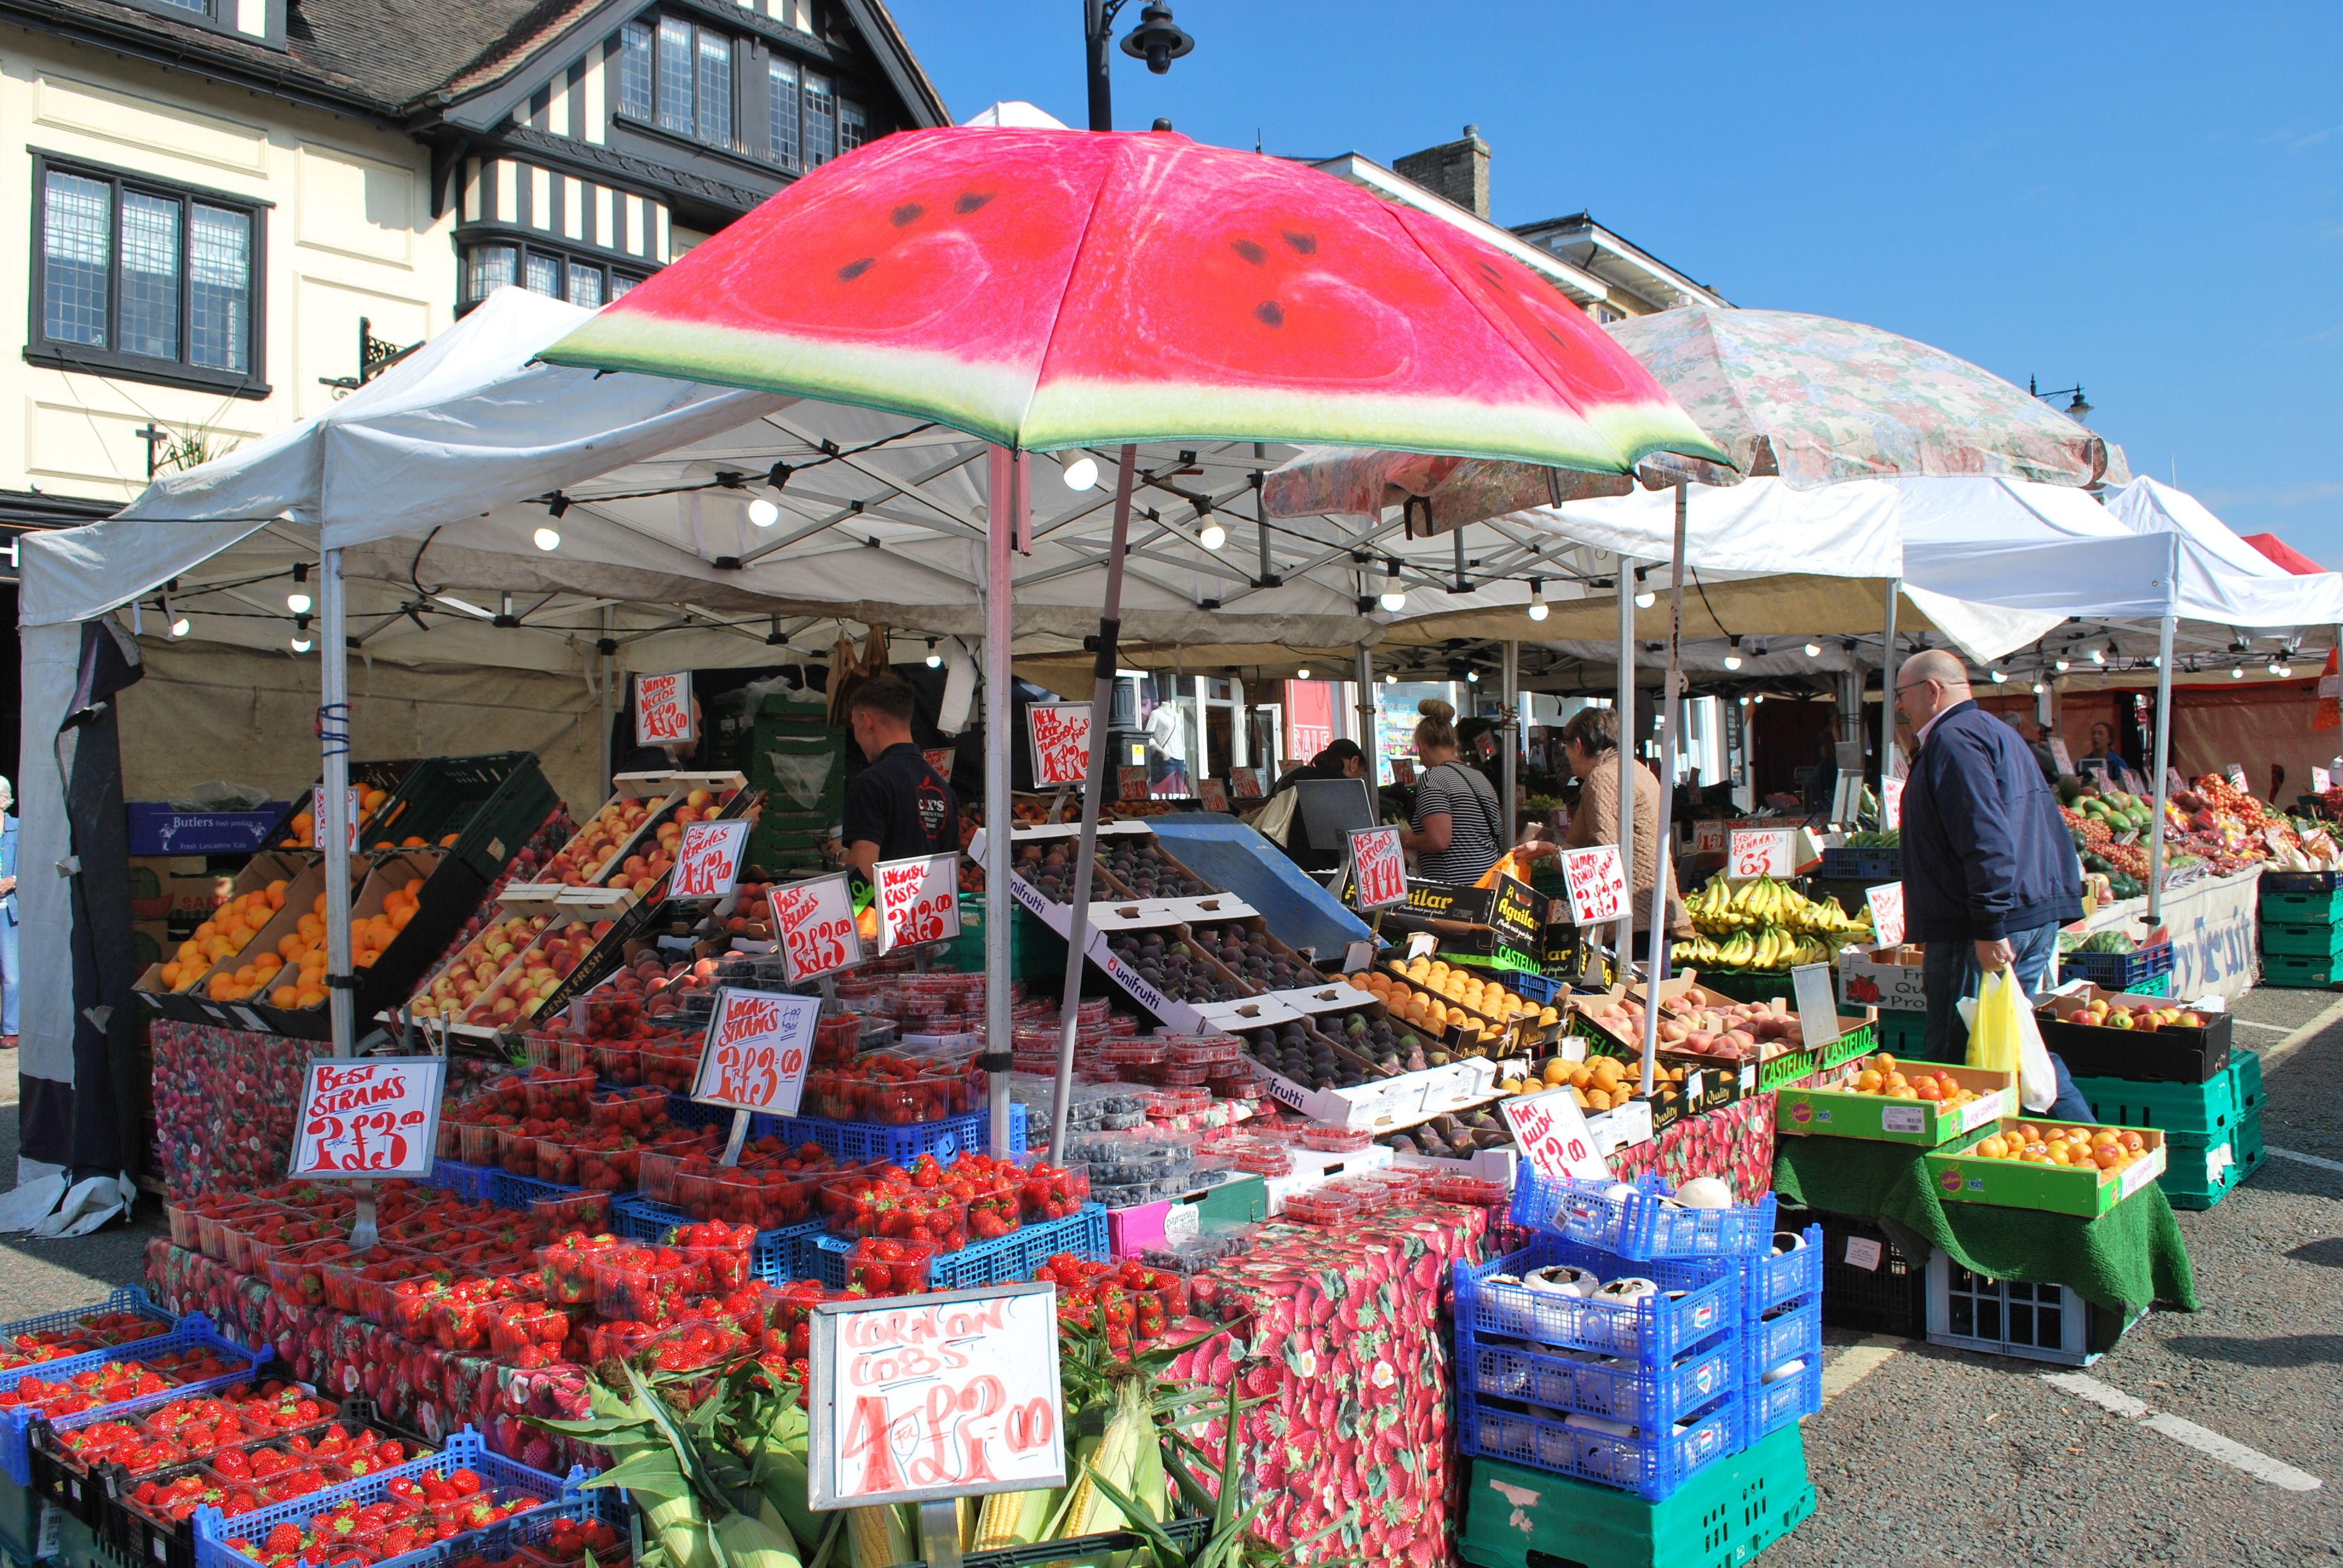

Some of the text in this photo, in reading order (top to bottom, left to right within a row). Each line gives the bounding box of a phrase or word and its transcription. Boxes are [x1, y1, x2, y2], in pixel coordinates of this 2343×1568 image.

[1033, 708, 1056, 730] NEW
[1294, 729, 1329, 766] SALE
[174, 817, 214, 827] Butlers
[1357, 830, 1392, 872] APRICOTS
[1568, 853, 1598, 872] JUMBO
[1732, 832, 1778, 857] BANANAS
[773, 886, 805, 915] BEST
[1011, 878, 1046, 914] nifrutti
[1498, 898, 1541, 931] Aguilar
[2194, 904, 2252, 988] Fruit
[571, 950, 604, 987] FRESH
[1116, 967, 1161, 1010] unifrutti
[718, 1008, 781, 1047] STRAWS
[1522, 1031, 1547, 1047] Quality
[308, 1076, 407, 1117] STRAWS
[316, 1064, 380, 1093] BEST
[1706, 1086, 1730, 1105] Quality
[1653, 1105, 1678, 1129] Quality
[303, 1116, 344, 1172] 2
[845, 1297, 1008, 1349] CORN ON
[849, 1342, 969, 1387] COBS
[841, 1394, 909, 1497] 4
